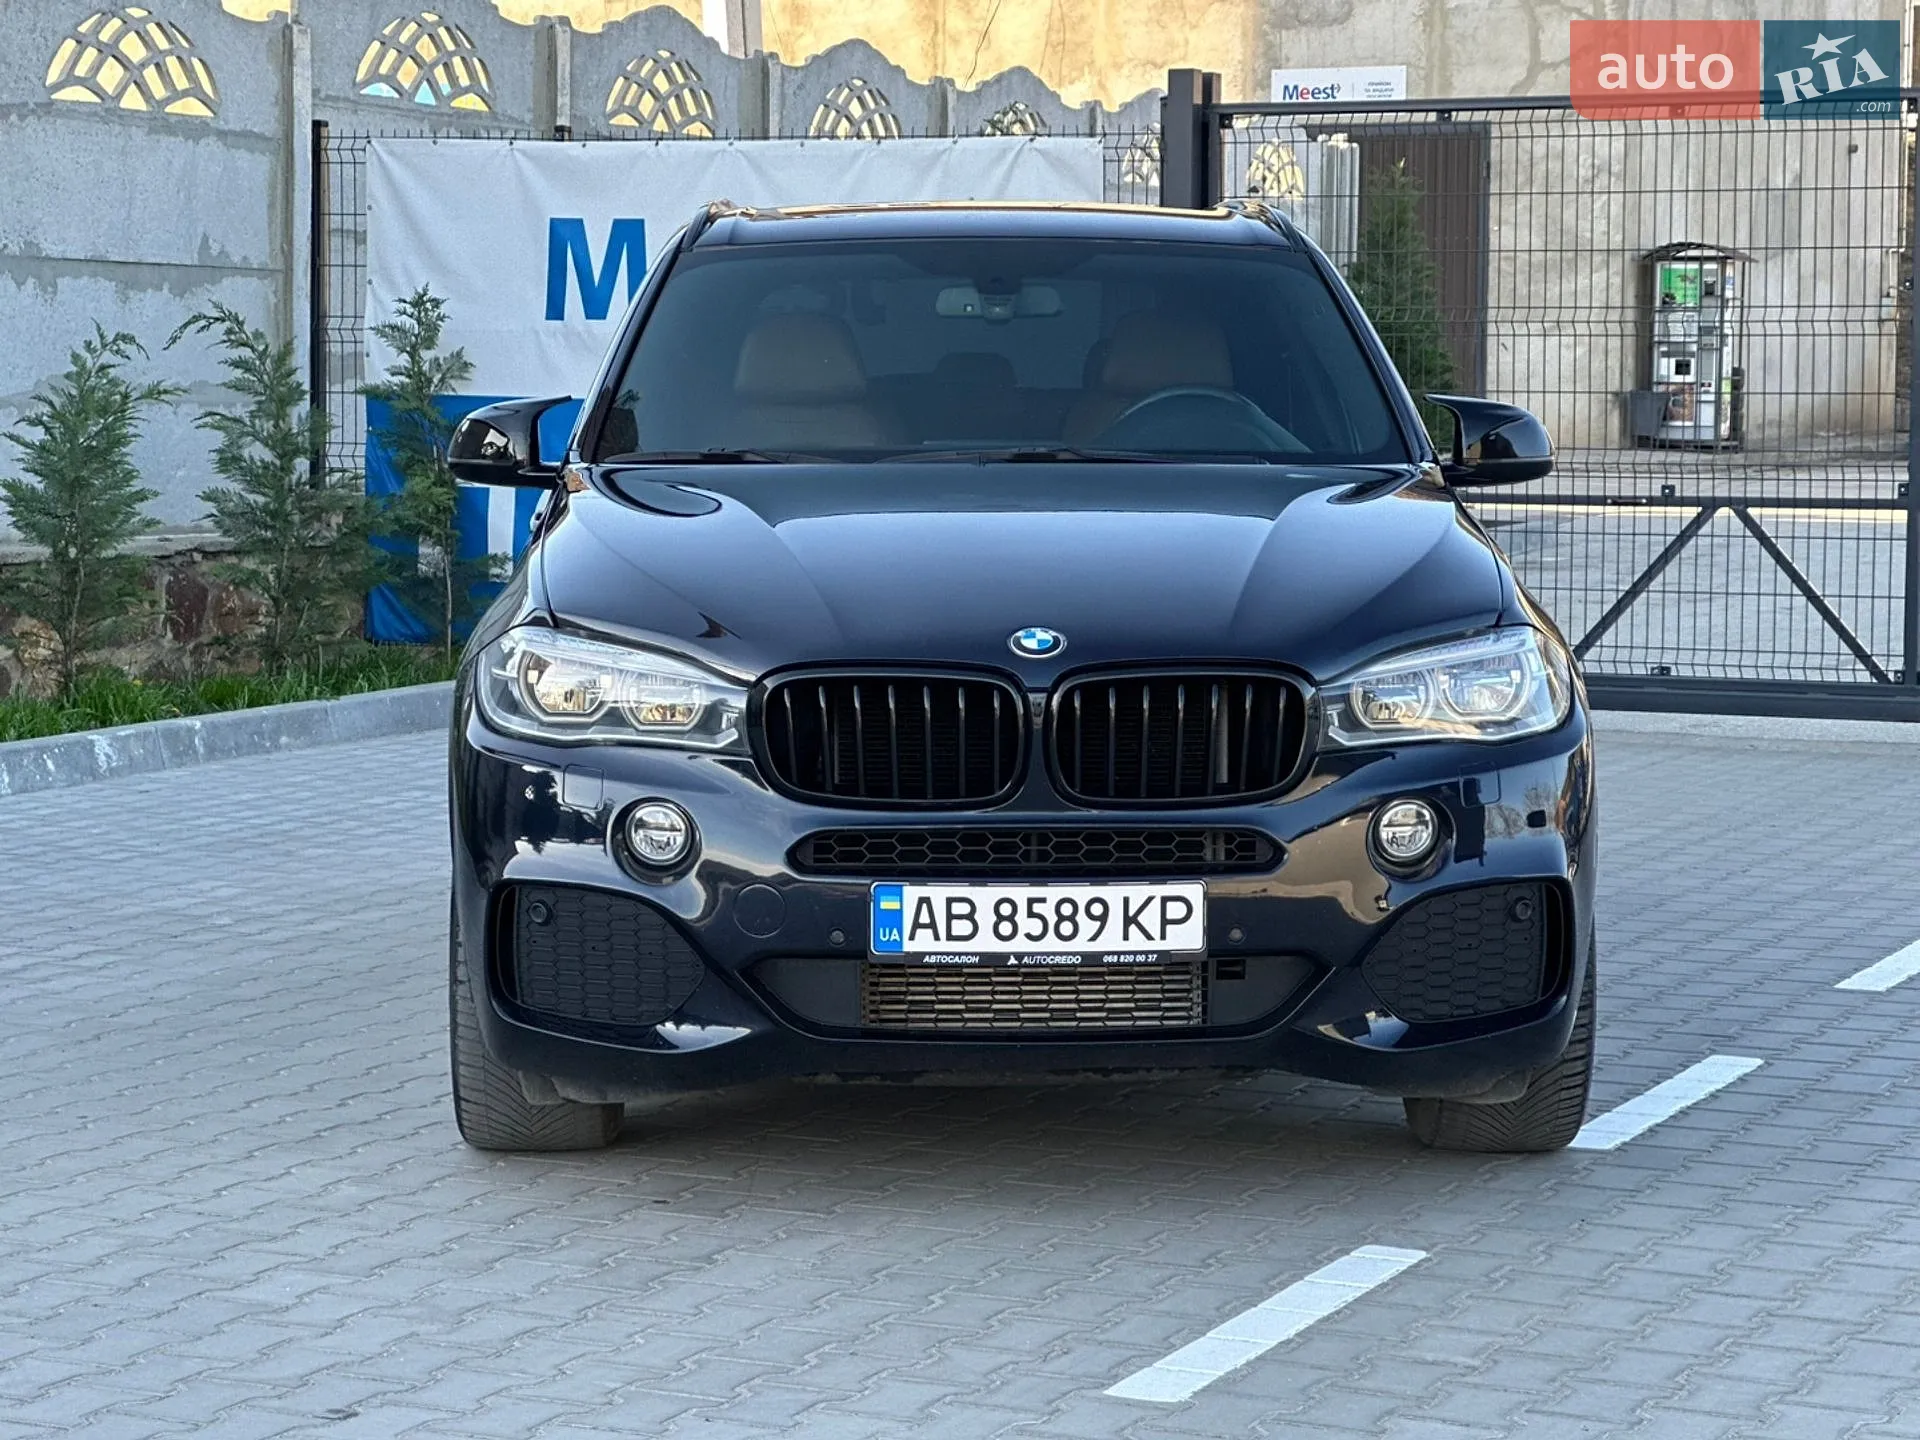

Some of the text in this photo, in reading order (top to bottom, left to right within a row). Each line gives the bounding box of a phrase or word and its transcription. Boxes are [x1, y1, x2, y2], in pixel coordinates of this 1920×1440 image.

[1282, 83, 1337, 101] Meest
[908, 895, 1194, 942] AB 8589 KP
[879, 927, 900, 942] UA
[922, 955, 980, 964] АВТОСАЛОН
[1021, 955, 1082, 965] AUTOCREDO
[1119, 955, 1135, 963] 820
[1135, 954, 1146, 963] 00
